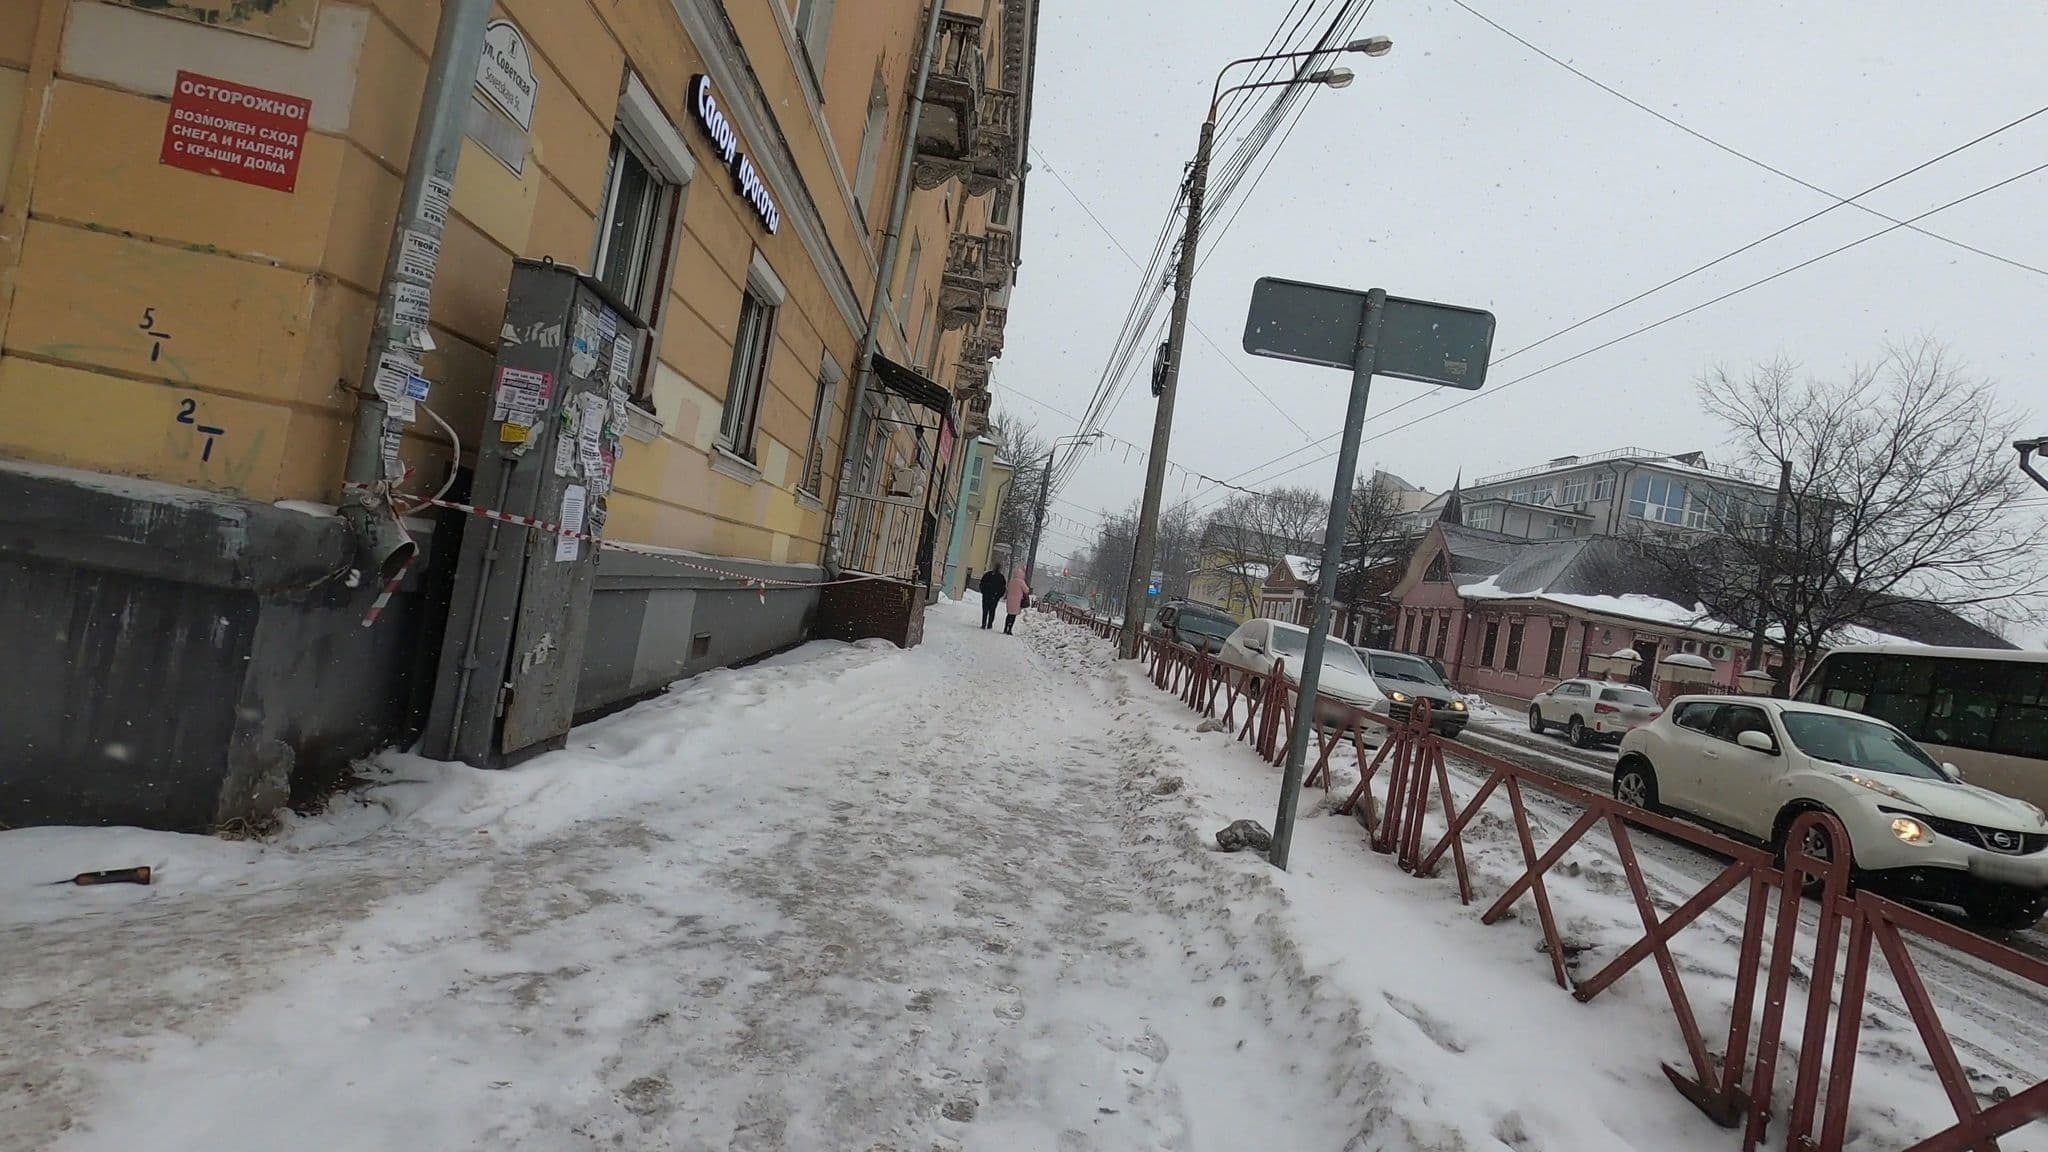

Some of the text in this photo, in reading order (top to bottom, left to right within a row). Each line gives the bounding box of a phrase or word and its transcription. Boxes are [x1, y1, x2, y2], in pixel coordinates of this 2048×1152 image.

[482, 39, 531, 96] ул. Советская
[180, 80, 305, 120] ОСТОРОЖНО!
[171, 124, 295, 161] СНЕГА И НАЛЕДИ
[174, 108, 298, 148] ВОЗМОЖЕН СХОД
[173, 140, 287, 175] С КРЫШИ ДОМА
[698, 74, 780, 235] Салон красоты
[139, 307, 156, 330] 5
[176, 398, 197, 425] 2
